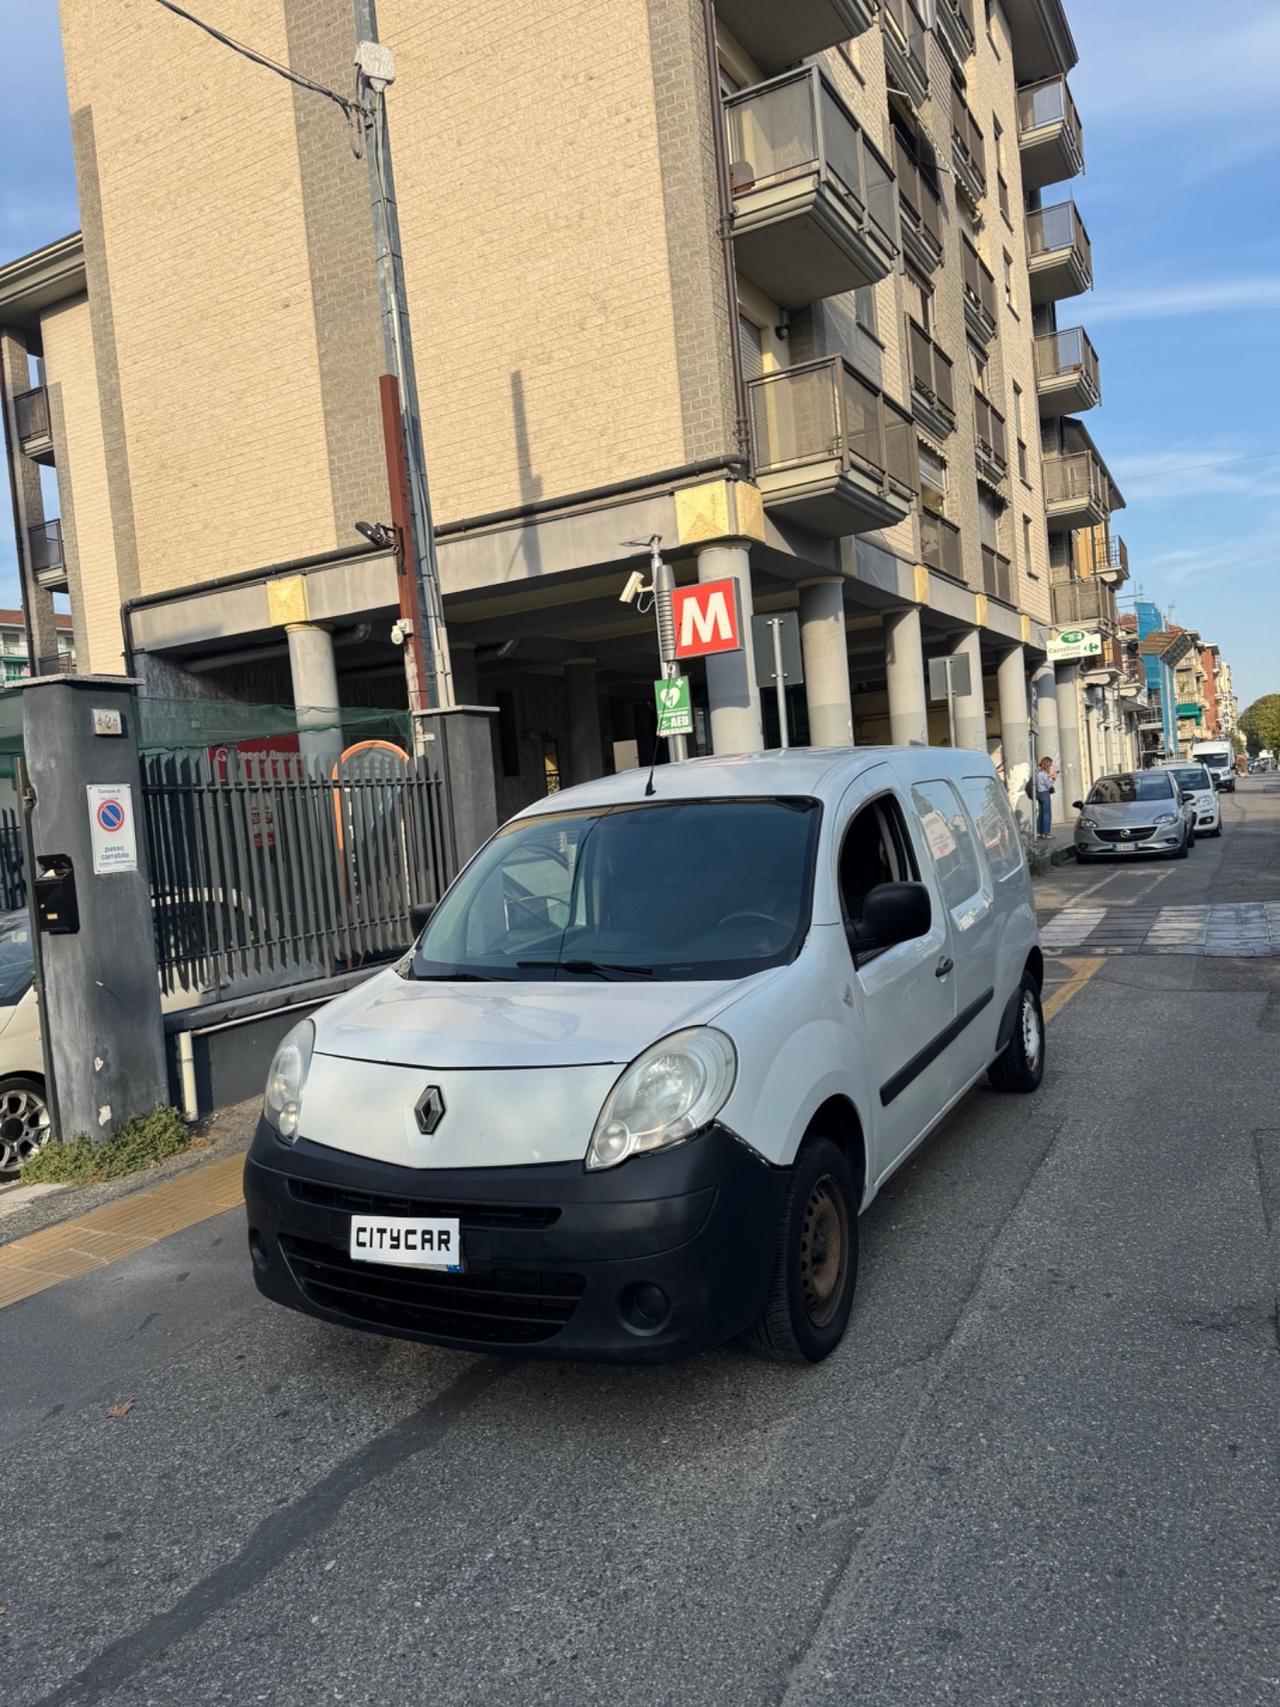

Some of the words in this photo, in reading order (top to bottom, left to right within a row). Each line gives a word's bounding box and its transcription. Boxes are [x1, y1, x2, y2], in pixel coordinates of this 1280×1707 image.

[680, 592, 734, 648] M
[671, 716, 689, 727] AED
[104, 845, 125, 853] passo
[101, 852, 130, 861] carrabile
[356, 1227, 451, 1252] CITYCAR
